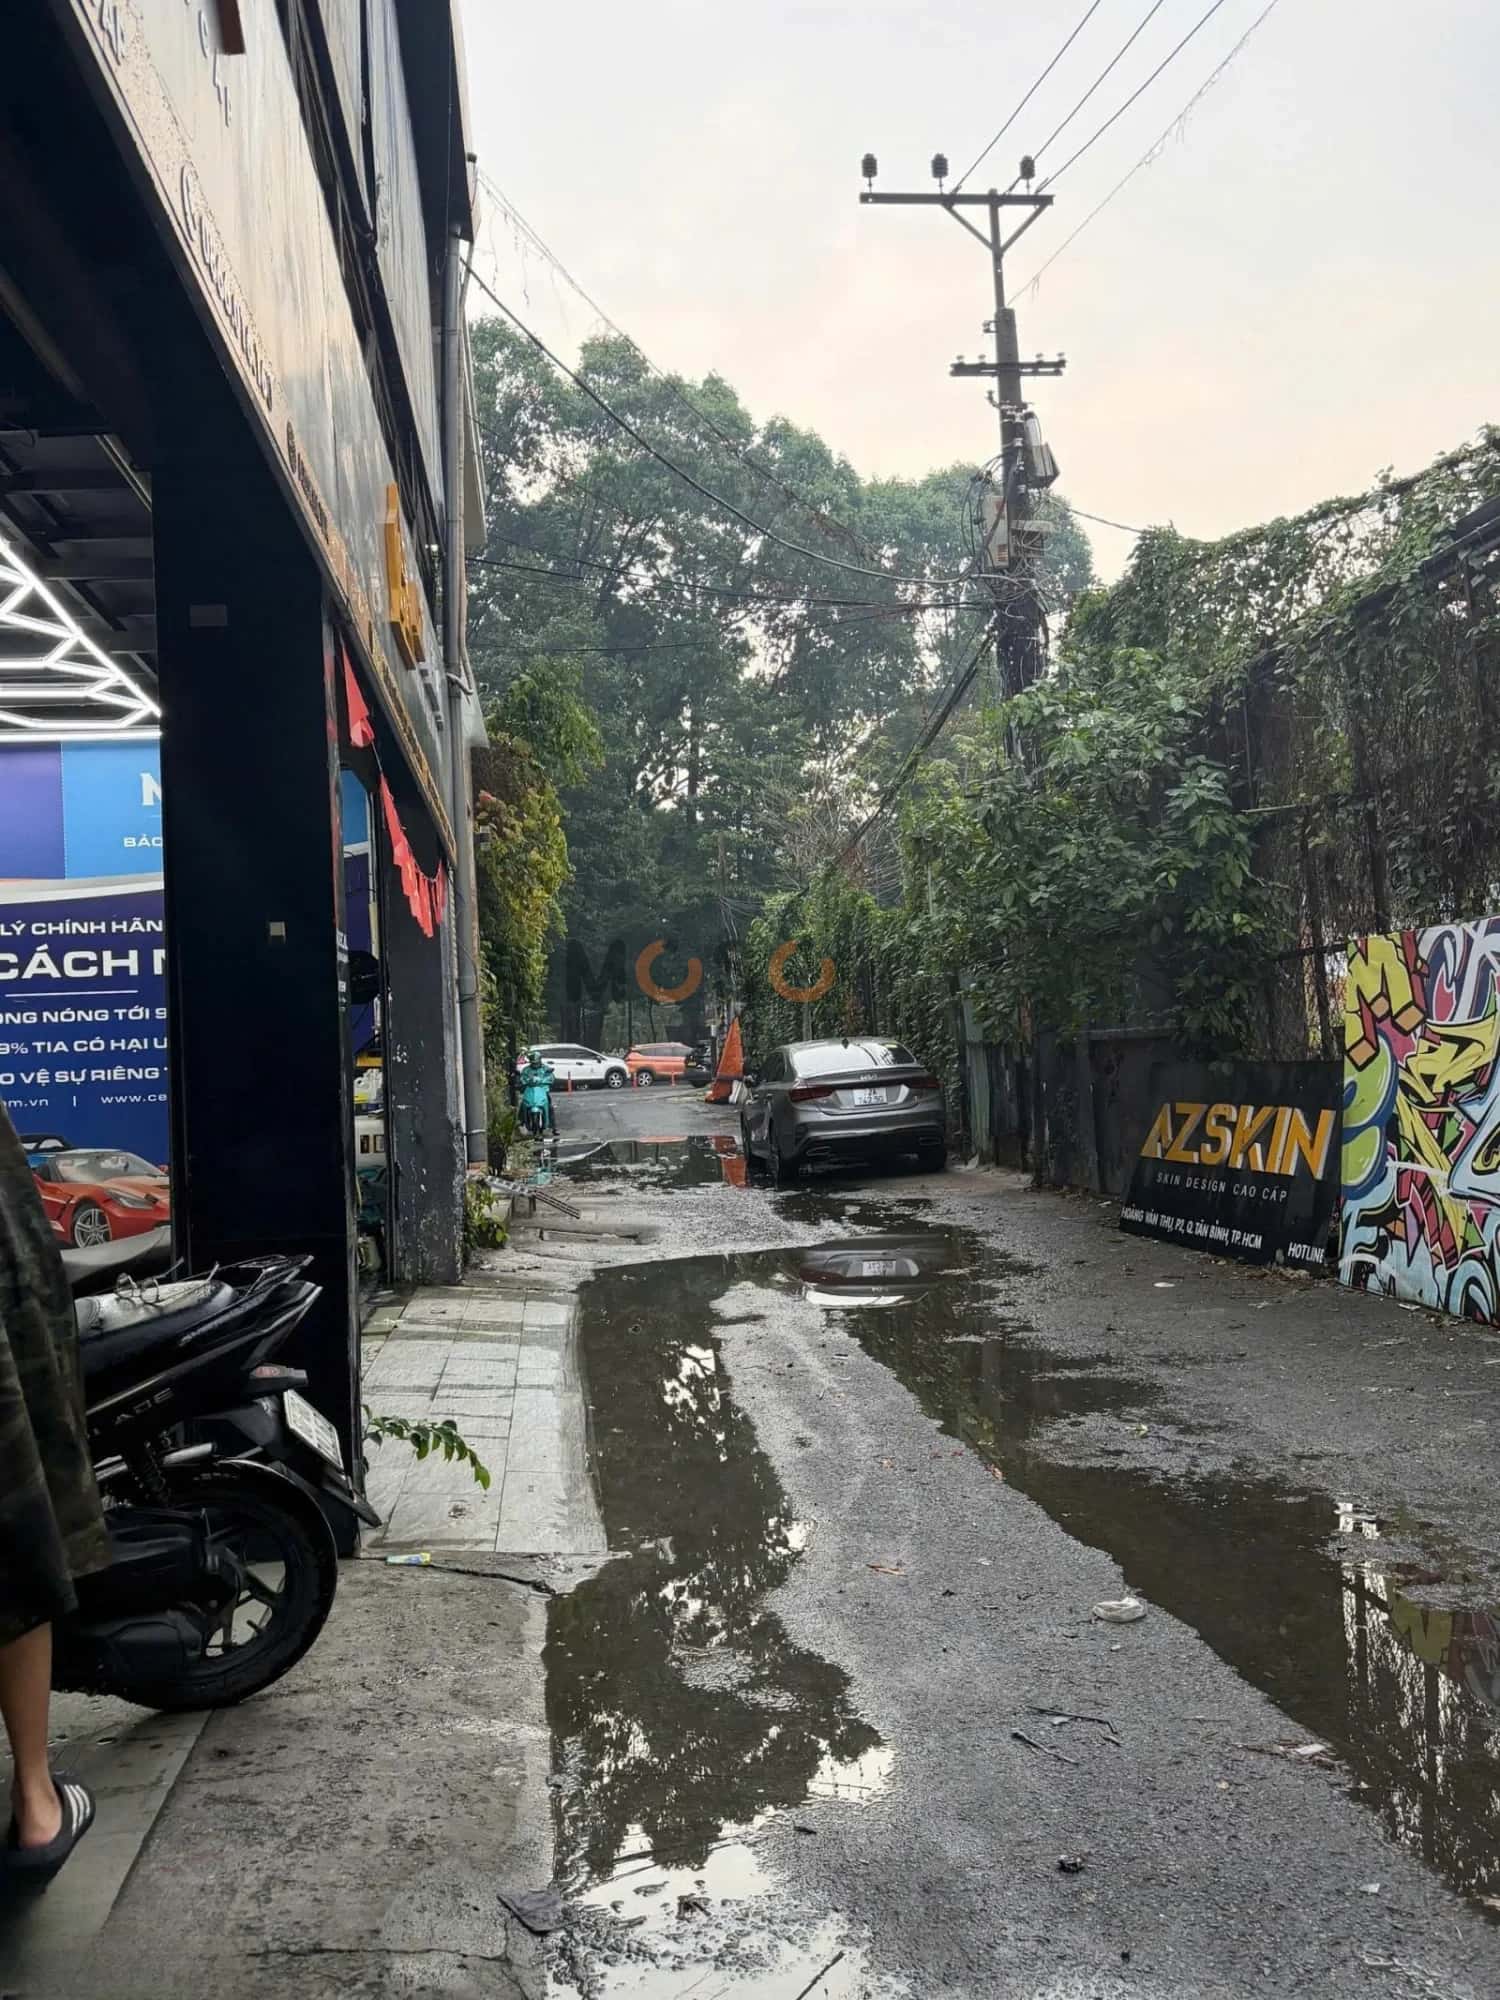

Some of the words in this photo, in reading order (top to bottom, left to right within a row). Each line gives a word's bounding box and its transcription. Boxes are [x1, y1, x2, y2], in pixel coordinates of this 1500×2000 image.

[0, 920, 26, 936] LÝ
[31, 918, 106, 935] CHÍNH
[0, 943, 139, 980] CÁCH
[0, 1011, 38, 1024] NG
[42, 1007, 110, 1023] NÓNG
[114, 1004, 150, 1020] TỚI
[32, 1041, 69, 1053] TIA
[73, 1036, 105, 1052] CÓ
[110, 1037, 148, 1053] HẠI
[20, 1068, 50, 1087] VỆ
[55, 1068, 87, 1085] SỰ
[91, 1065, 160, 1081] RIÊNG
[1140, 1102, 1337, 1181] AZSKIN
[1156, 1172, 1181, 1185] SKIN
[1185, 1175, 1226, 1193] DESIGN
[1232, 1183, 1257, 1198] CAO
[1287, 1241, 1325, 1264] HOTLINE
